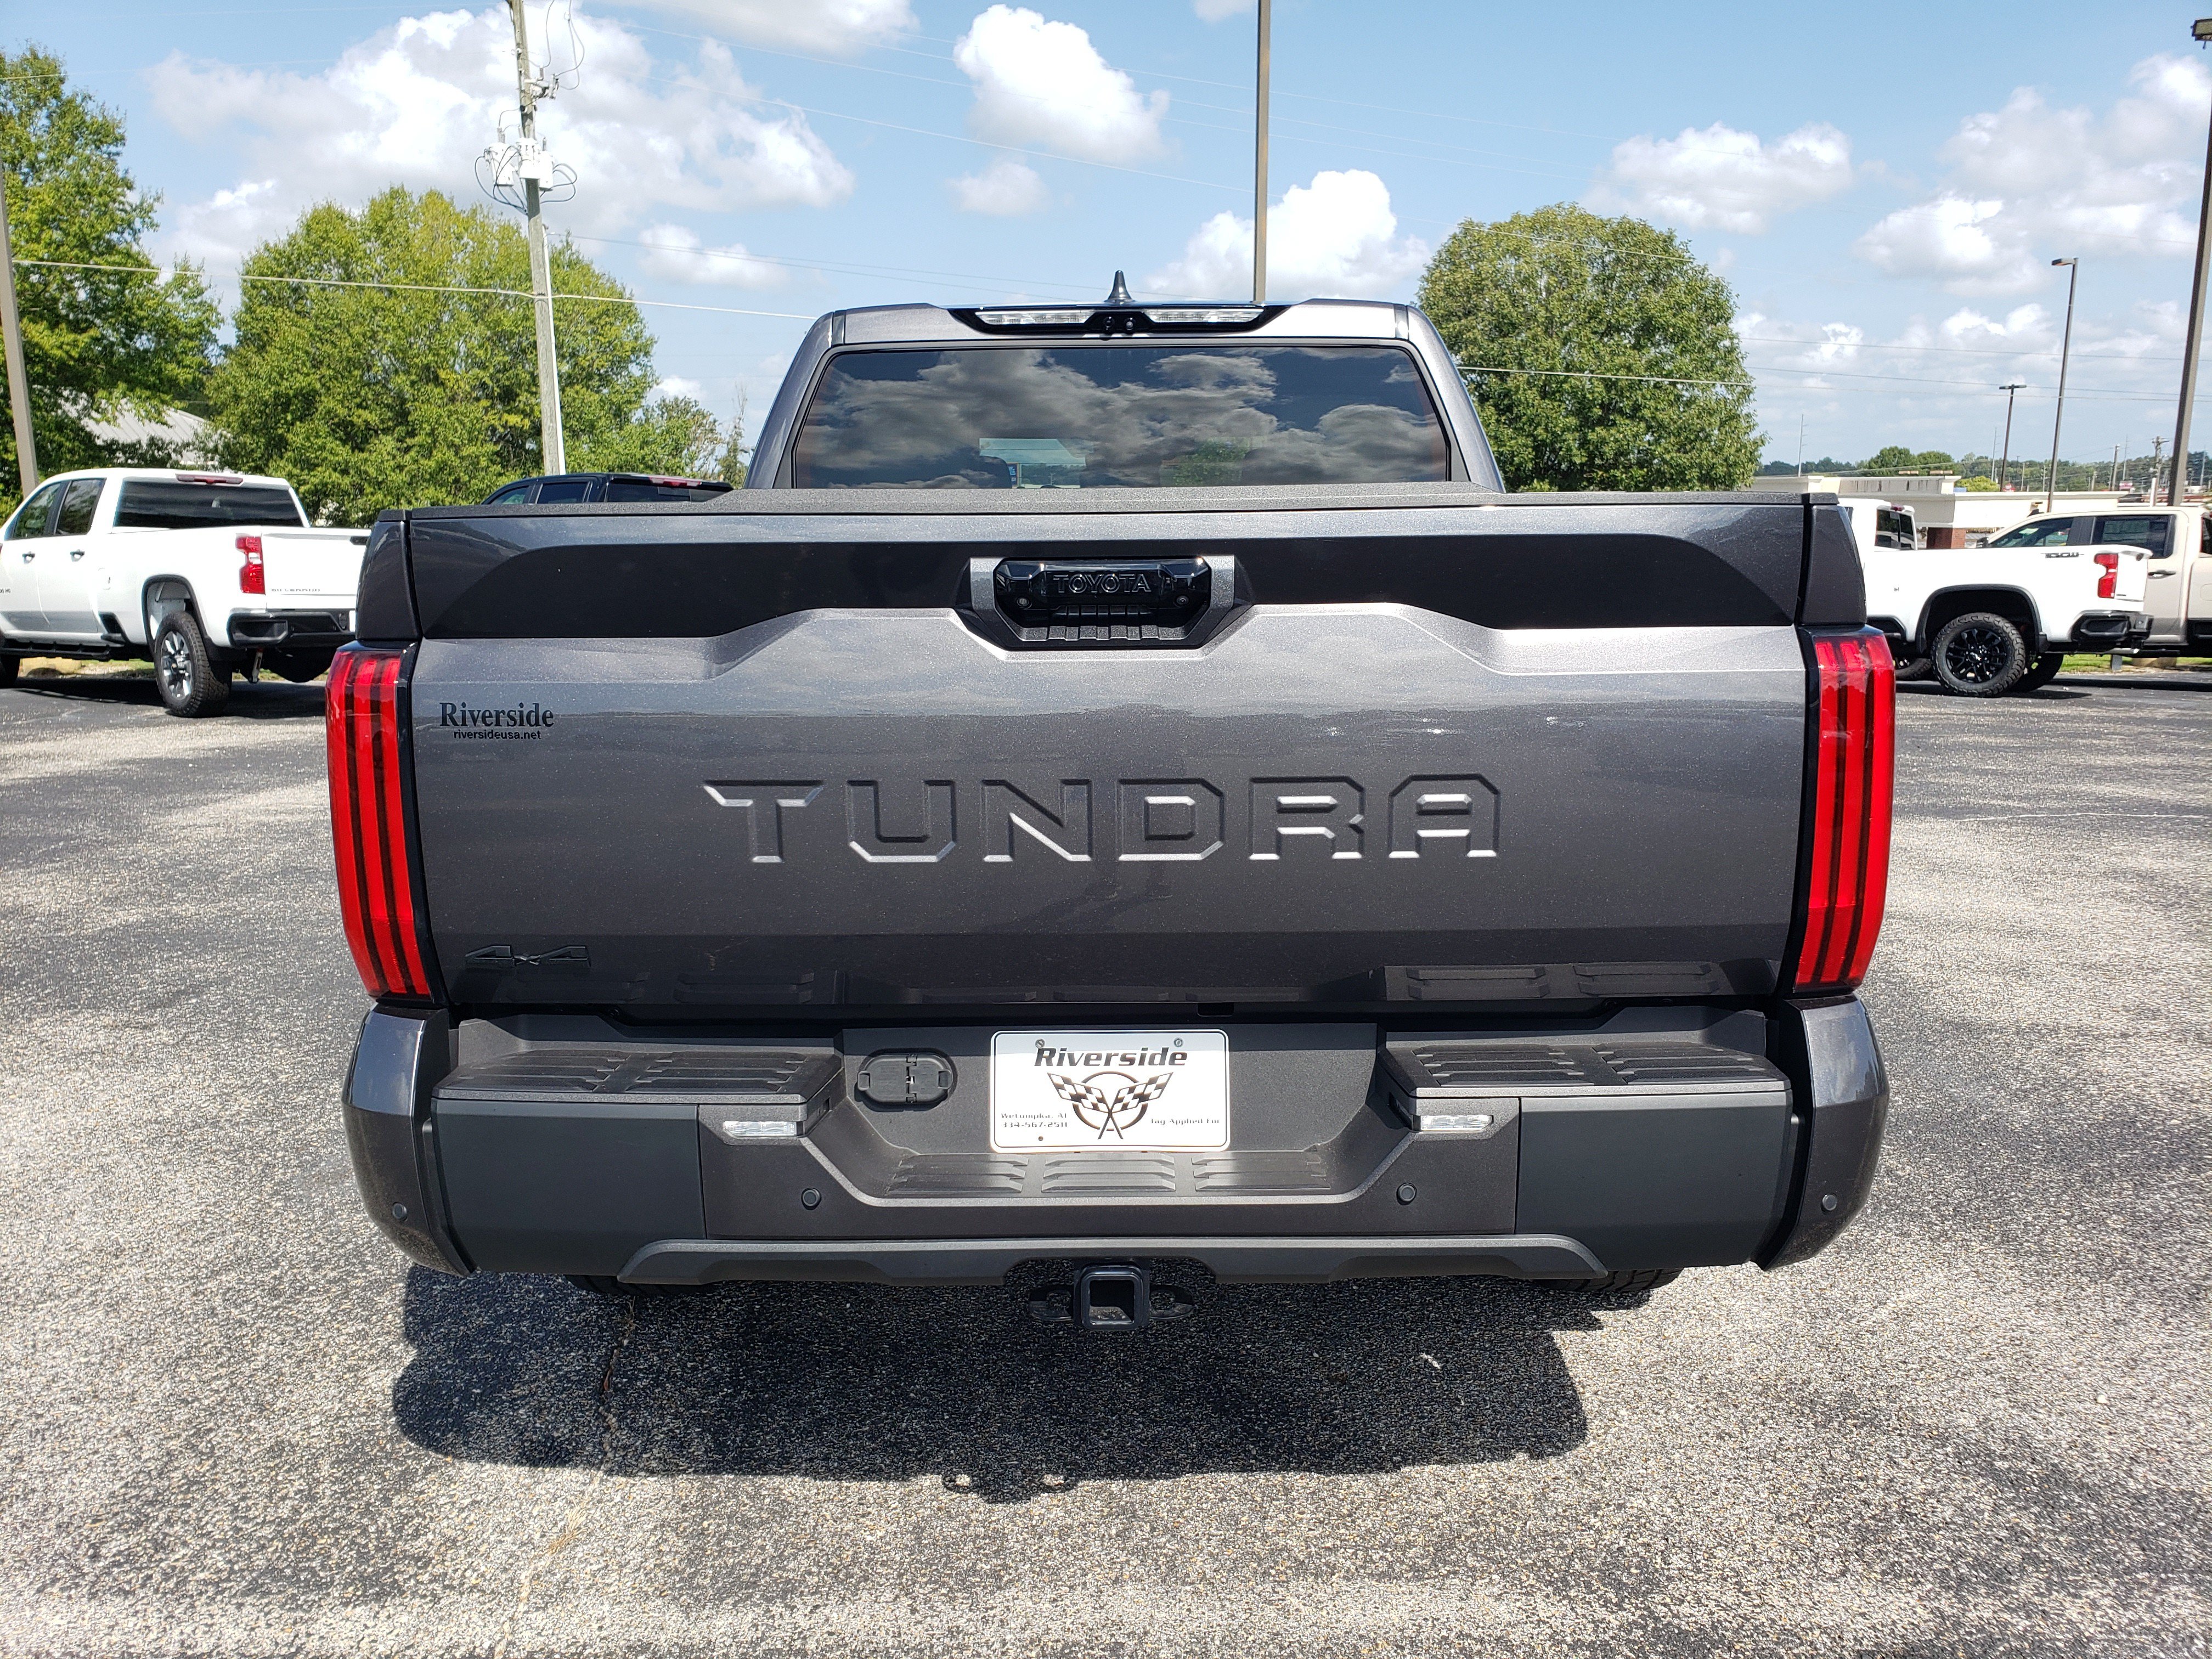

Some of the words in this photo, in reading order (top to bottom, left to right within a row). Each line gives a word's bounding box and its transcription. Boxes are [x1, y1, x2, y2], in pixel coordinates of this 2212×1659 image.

[1053, 574, 1152, 594] TOYOTA
[439, 702, 555, 727] Riverside
[454, 729, 541, 740] riversideusa.net
[703, 772, 1501, 864] TUNDRA
[1034, 1047, 1188, 1066] Riverside
